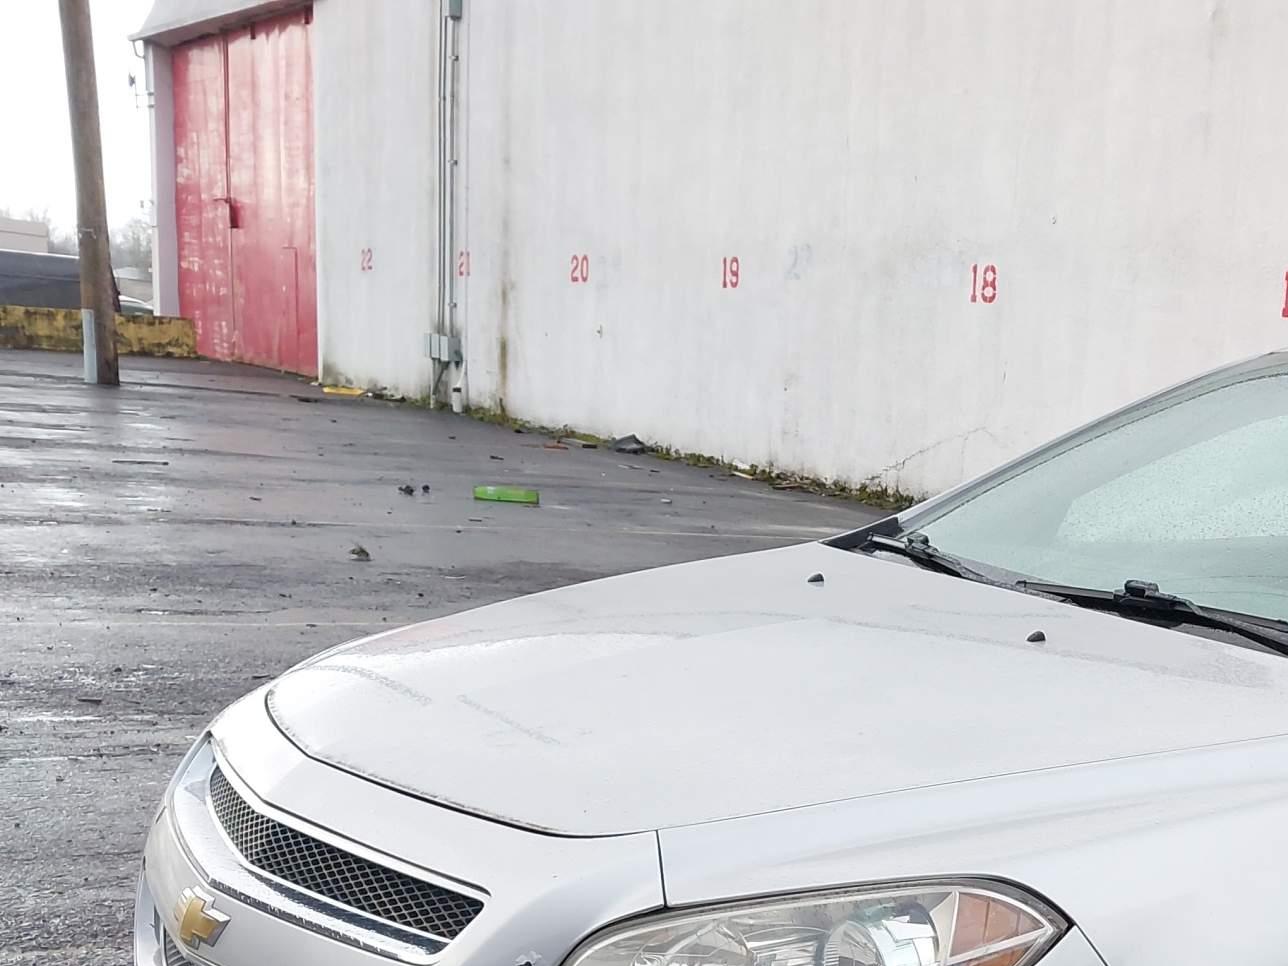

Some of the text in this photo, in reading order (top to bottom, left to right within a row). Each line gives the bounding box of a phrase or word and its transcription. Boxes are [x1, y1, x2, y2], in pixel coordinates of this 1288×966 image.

[361, 248, 373, 271] 22
[570, 254, 589, 283] 20
[722, 256, 740, 289] 19
[970, 264, 999, 305] 18
